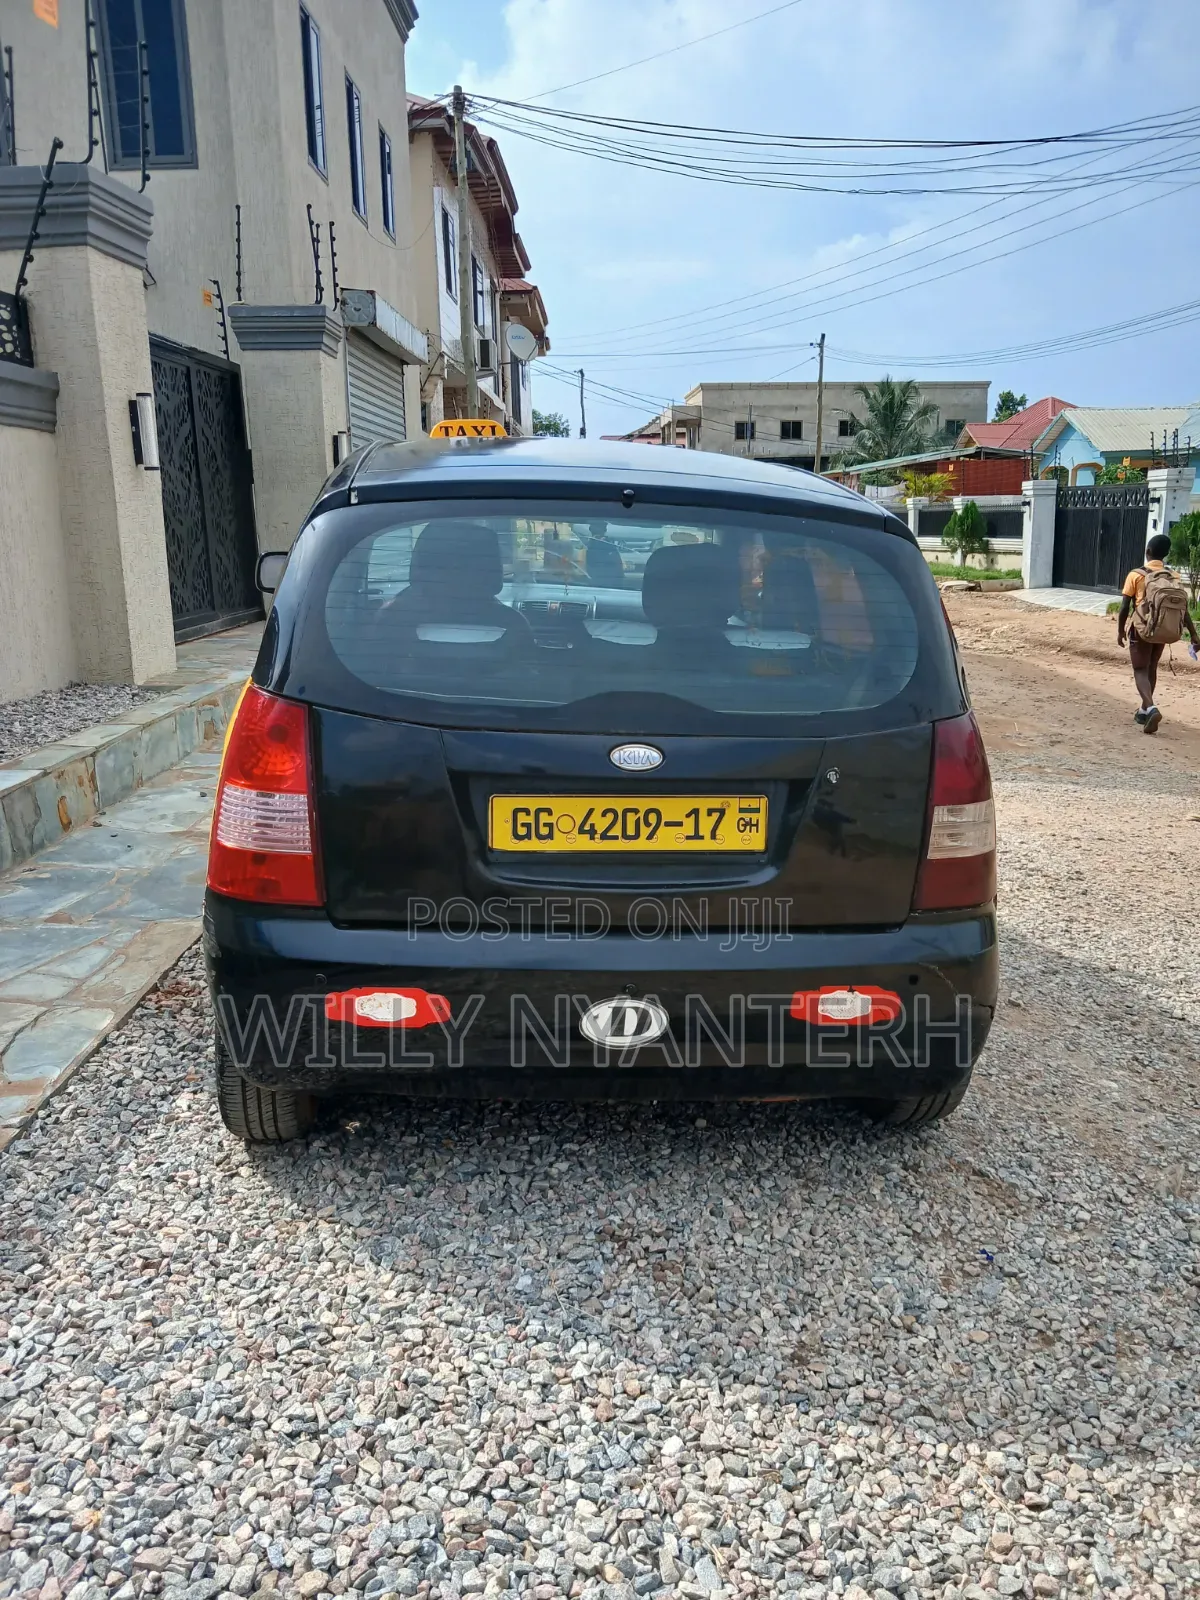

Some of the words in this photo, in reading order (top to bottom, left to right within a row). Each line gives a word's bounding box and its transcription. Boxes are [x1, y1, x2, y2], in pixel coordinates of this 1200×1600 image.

[439, 425, 497, 437] TAXI
[618, 750, 654, 765] KIA
[512, 807, 554, 841] GG
[578, 807, 726, 841] 4209-17
[736, 817, 759, 834] GH
